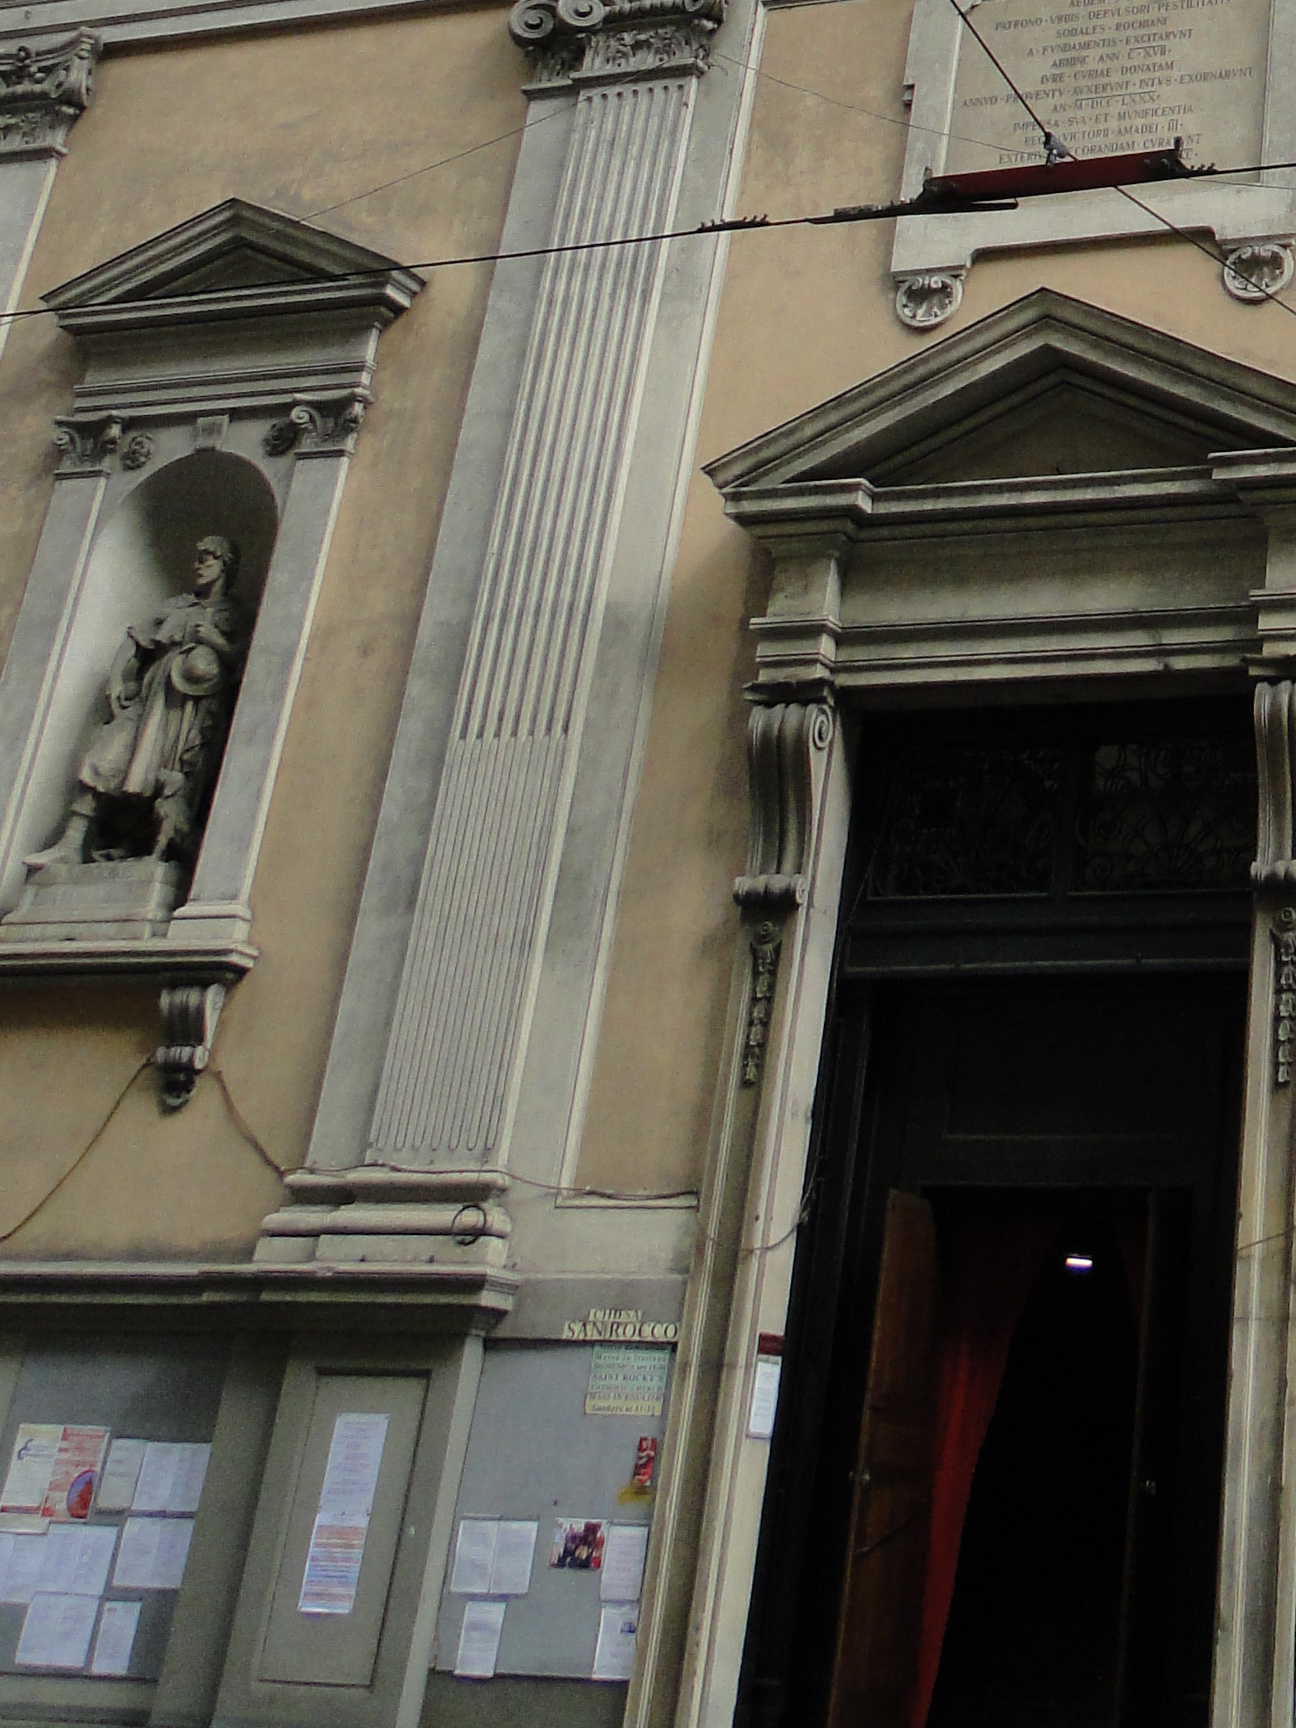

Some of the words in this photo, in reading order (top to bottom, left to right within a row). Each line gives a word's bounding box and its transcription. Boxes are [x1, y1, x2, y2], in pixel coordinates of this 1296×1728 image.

[995, 16, 1043, 32] PATRONO
[1049, 12, 1080, 25] VRBIS
[1056, 23, 1105, 40] SODALES
[1115, 16, 1168, 32] ROCHIANI
[1042, 37, 1117, 56] FVNDAMENTIS
[1125, 28, 1193, 46] EXCITARVNT
[1073, 67, 1113, 82] CVRIAE
[1120, 60, 1175, 76] DONATAM
[1139, 75, 1173, 90] INTVS
[1013, 117, 1060, 133] IMPESA
[1094, 112, 1110, 124] ET
[1116, 104, 1194, 122] MVNIFICENTIA
[1117, 122, 1159, 137] AMADEI
[567, 1322, 603, 1338] SAN
[609, 1322, 678, 1339] ROCCO
